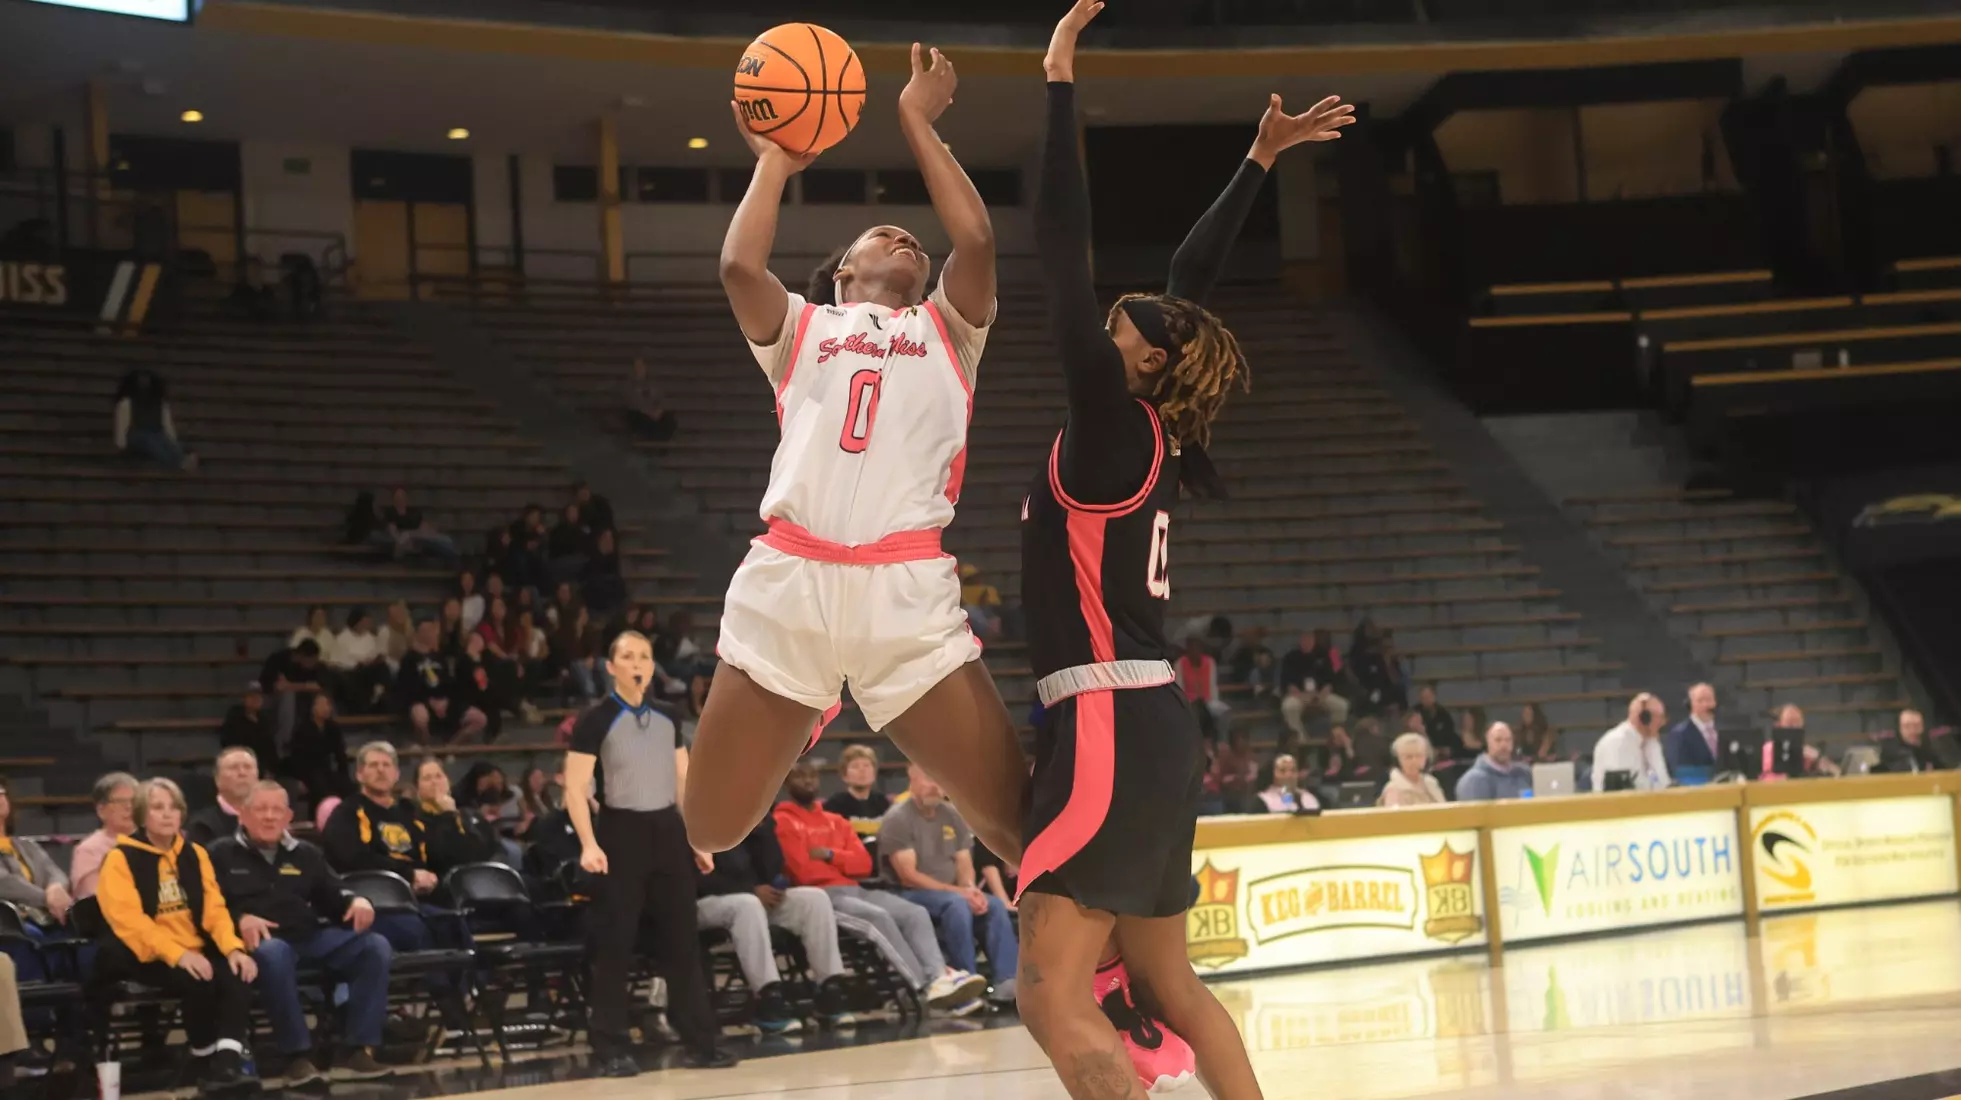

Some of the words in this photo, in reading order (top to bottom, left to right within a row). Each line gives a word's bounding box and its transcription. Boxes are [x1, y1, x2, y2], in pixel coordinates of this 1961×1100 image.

[0, 261, 67, 305] ISS
[839, 368, 882, 455] 0
[1260, 886, 1301, 926] KEG
[1326, 880, 1405, 913] BARREL
[1640, 893, 1669, 910] AND
